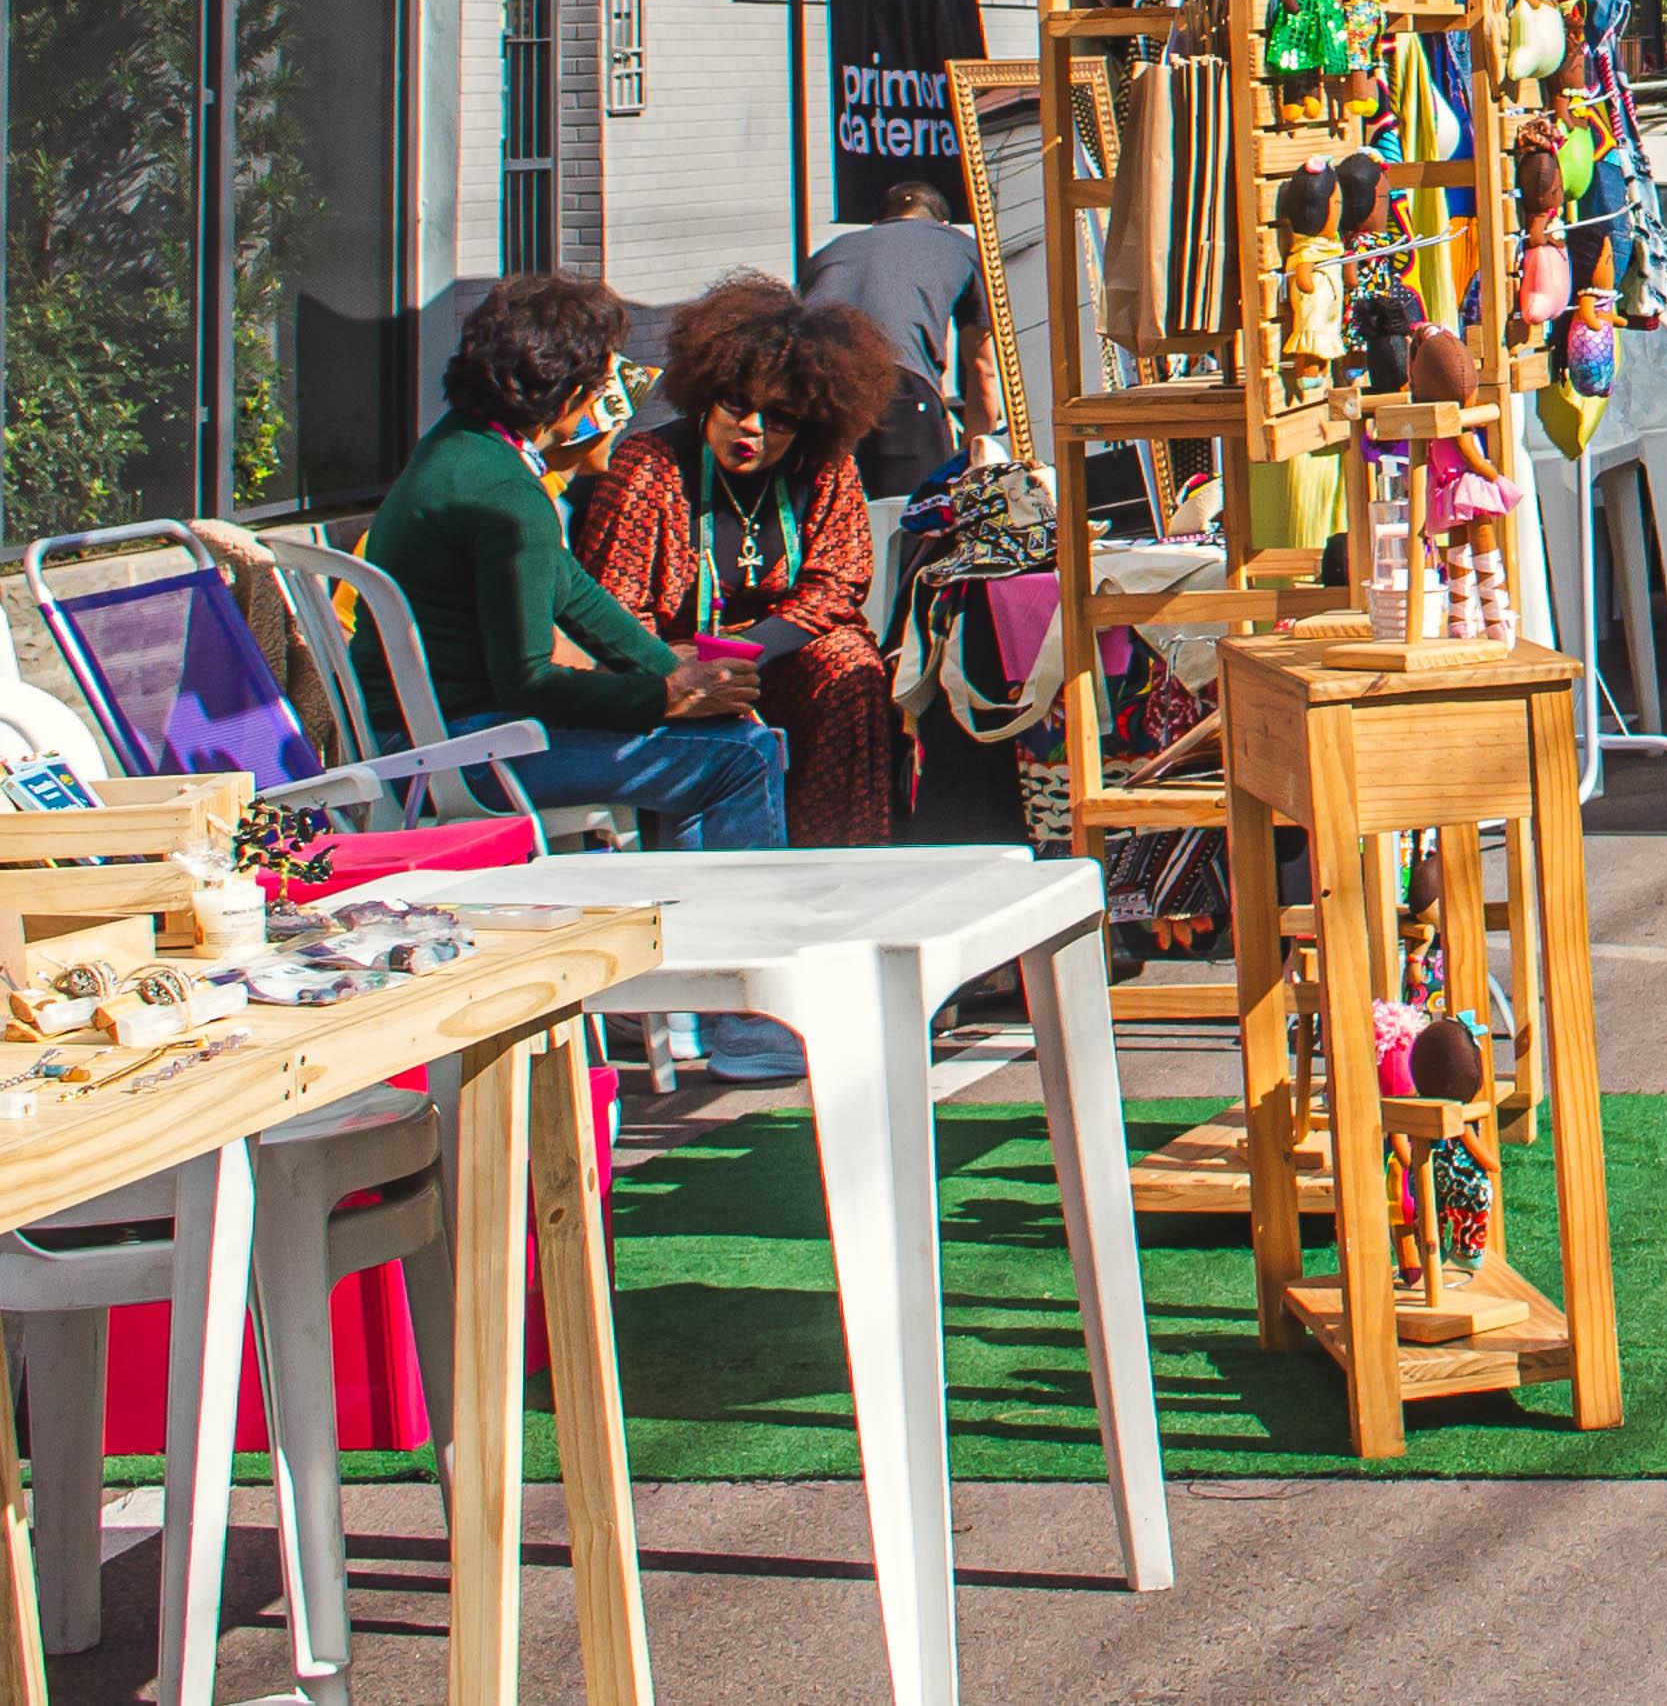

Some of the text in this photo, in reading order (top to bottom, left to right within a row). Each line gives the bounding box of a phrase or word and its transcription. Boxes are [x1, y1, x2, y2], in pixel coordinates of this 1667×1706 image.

[842, 52, 946, 110] primor
[839, 108, 961, 157] da terra
